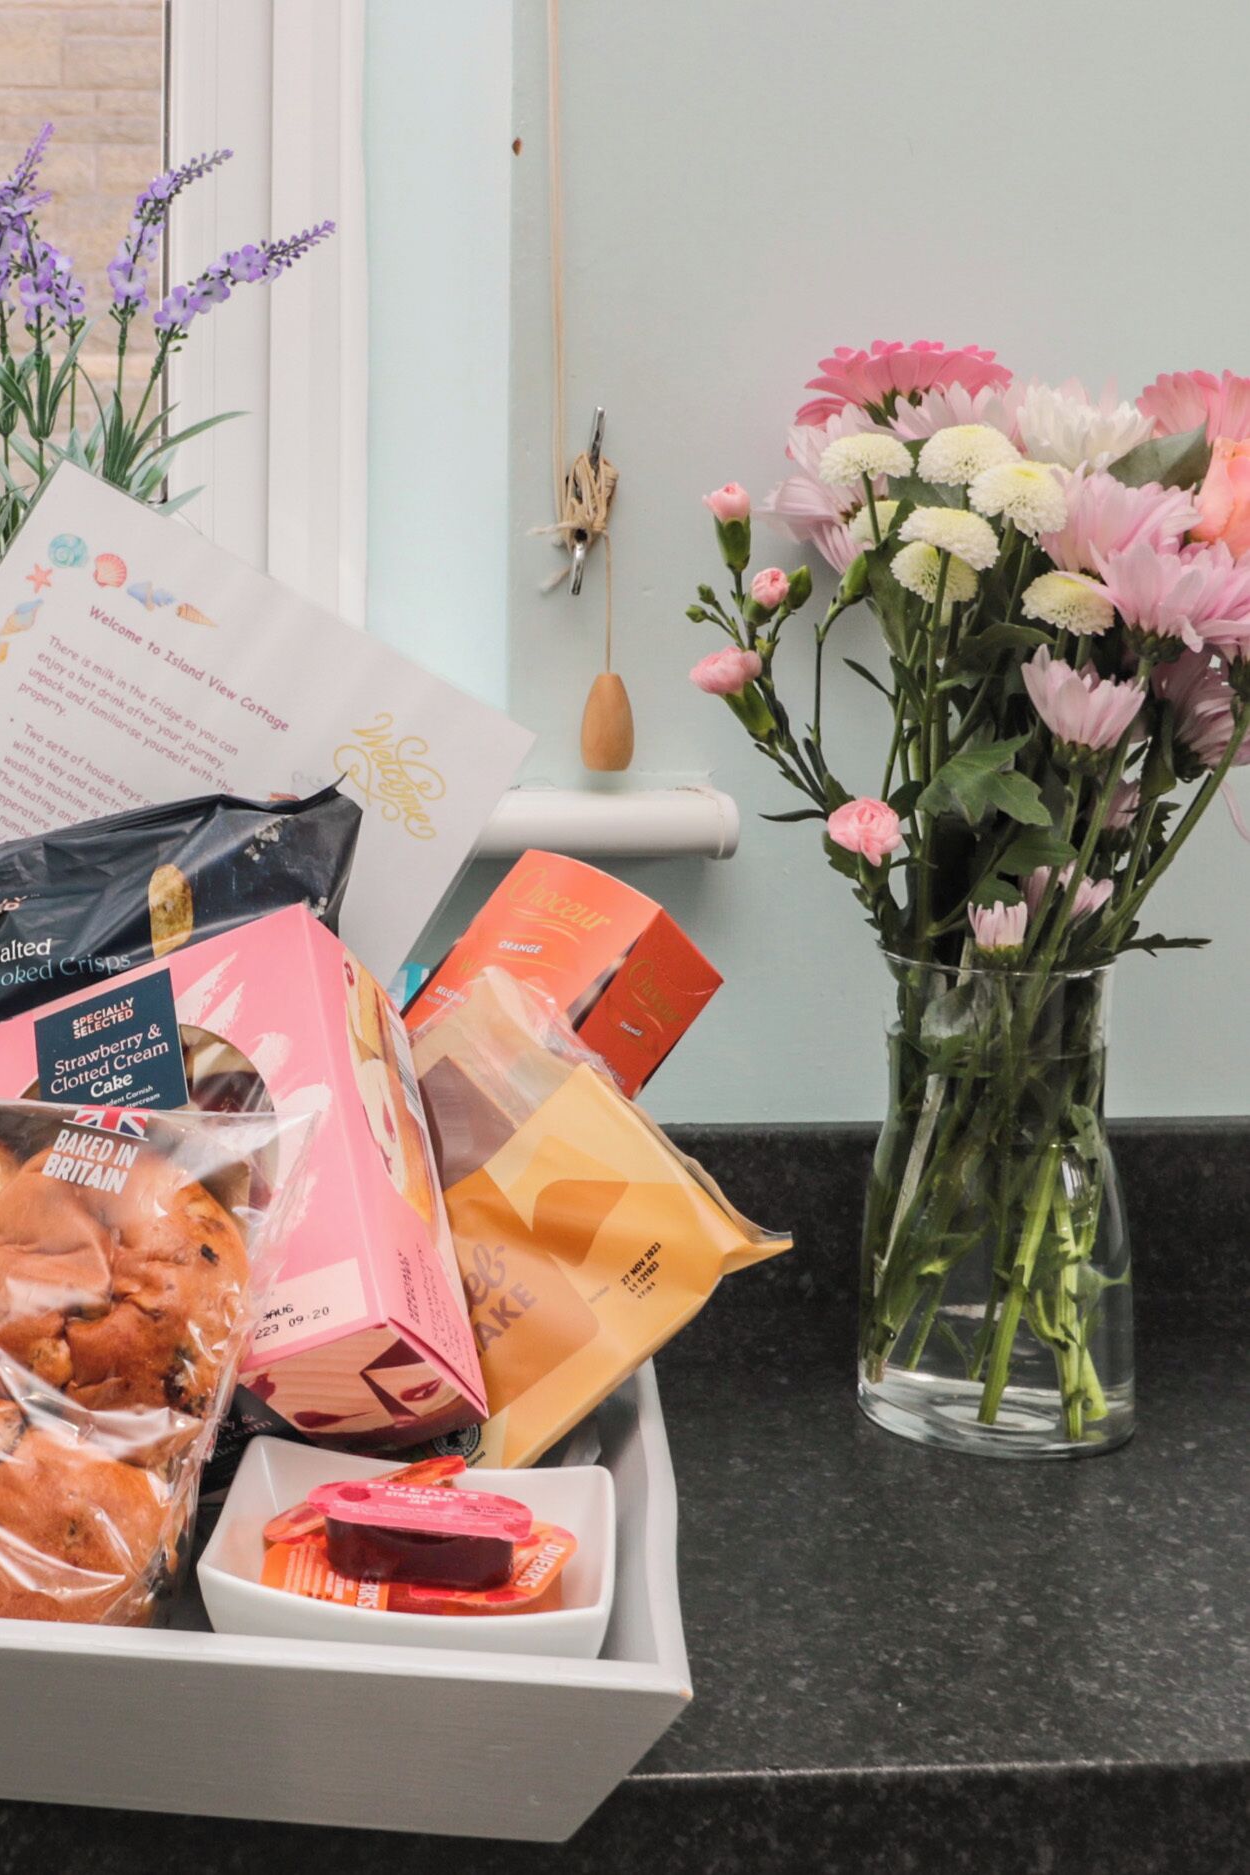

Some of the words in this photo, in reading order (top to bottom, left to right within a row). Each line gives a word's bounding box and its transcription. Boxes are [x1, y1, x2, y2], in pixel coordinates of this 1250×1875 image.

[89, 604, 143, 645] Welcome
[147, 641, 161, 655] to
[164, 650, 206, 681] Island
[208, 675, 237, 700] View
[240, 696, 289, 732] Cottage
[37, 652, 67, 675] enjoy
[68, 670, 76, 679] a
[77, 673, 96, 690] hot
[97, 687, 126, 710] drink
[126, 705, 157, 727] after
[156, 723, 183, 742] your
[49, 635, 79, 661] There
[81, 655, 91, 668] is
[92, 664, 115, 682] milk
[116, 678, 127, 690] in
[129, 684, 147, 701] the
[149, 696, 183, 722] fridge
[183, 719, 197, 731] so
[198, 727, 218, 744] you
[218, 740, 239, 756] can
[29, 667, 65, 694] unpack
[65, 690, 88, 707] and
[87, 700, 142, 740] familiarise
[142, 735, 190, 768] yourself
[189, 763, 213, 783] with
[215, 777, 235, 795] the
[3, 755, 46, 787] washing
[45, 780, 89, 811] machine
[12, 739, 37, 760] with
[37, 755, 46, 765] a
[46, 758, 68, 779] key
[66, 773, 90, 790] and
[24, 722, 44, 743] Two
[45, 740, 70, 758] sets
[70, 754, 86, 766] of
[85, 759, 116, 786] house
[117, 780, 143, 801] keys
[17, 782, 57, 815] heating
[59, 953, 131, 977] Crisps
[498, 940, 543, 954] ORANGE
[72, 997, 134, 1030] SPECIALLY
[73, 1008, 134, 1039] SELECTED
[50, 1060, 110, 1095] Clotted
[113, 1041, 169, 1071] Cream
[54, 1032, 144, 1076] Strawberry
[147, 1023, 162, 1040] &
[90, 1073, 133, 1098] Cake
[41, 1152, 128, 1195] BRITAIN
[53, 1128, 114, 1162] BAKED
[113, 1143, 139, 1169] IN
[621, 1274, 631, 1285] 27
[630, 1258, 646, 1276] NOV
[473, 1283, 538, 1358] AKE
